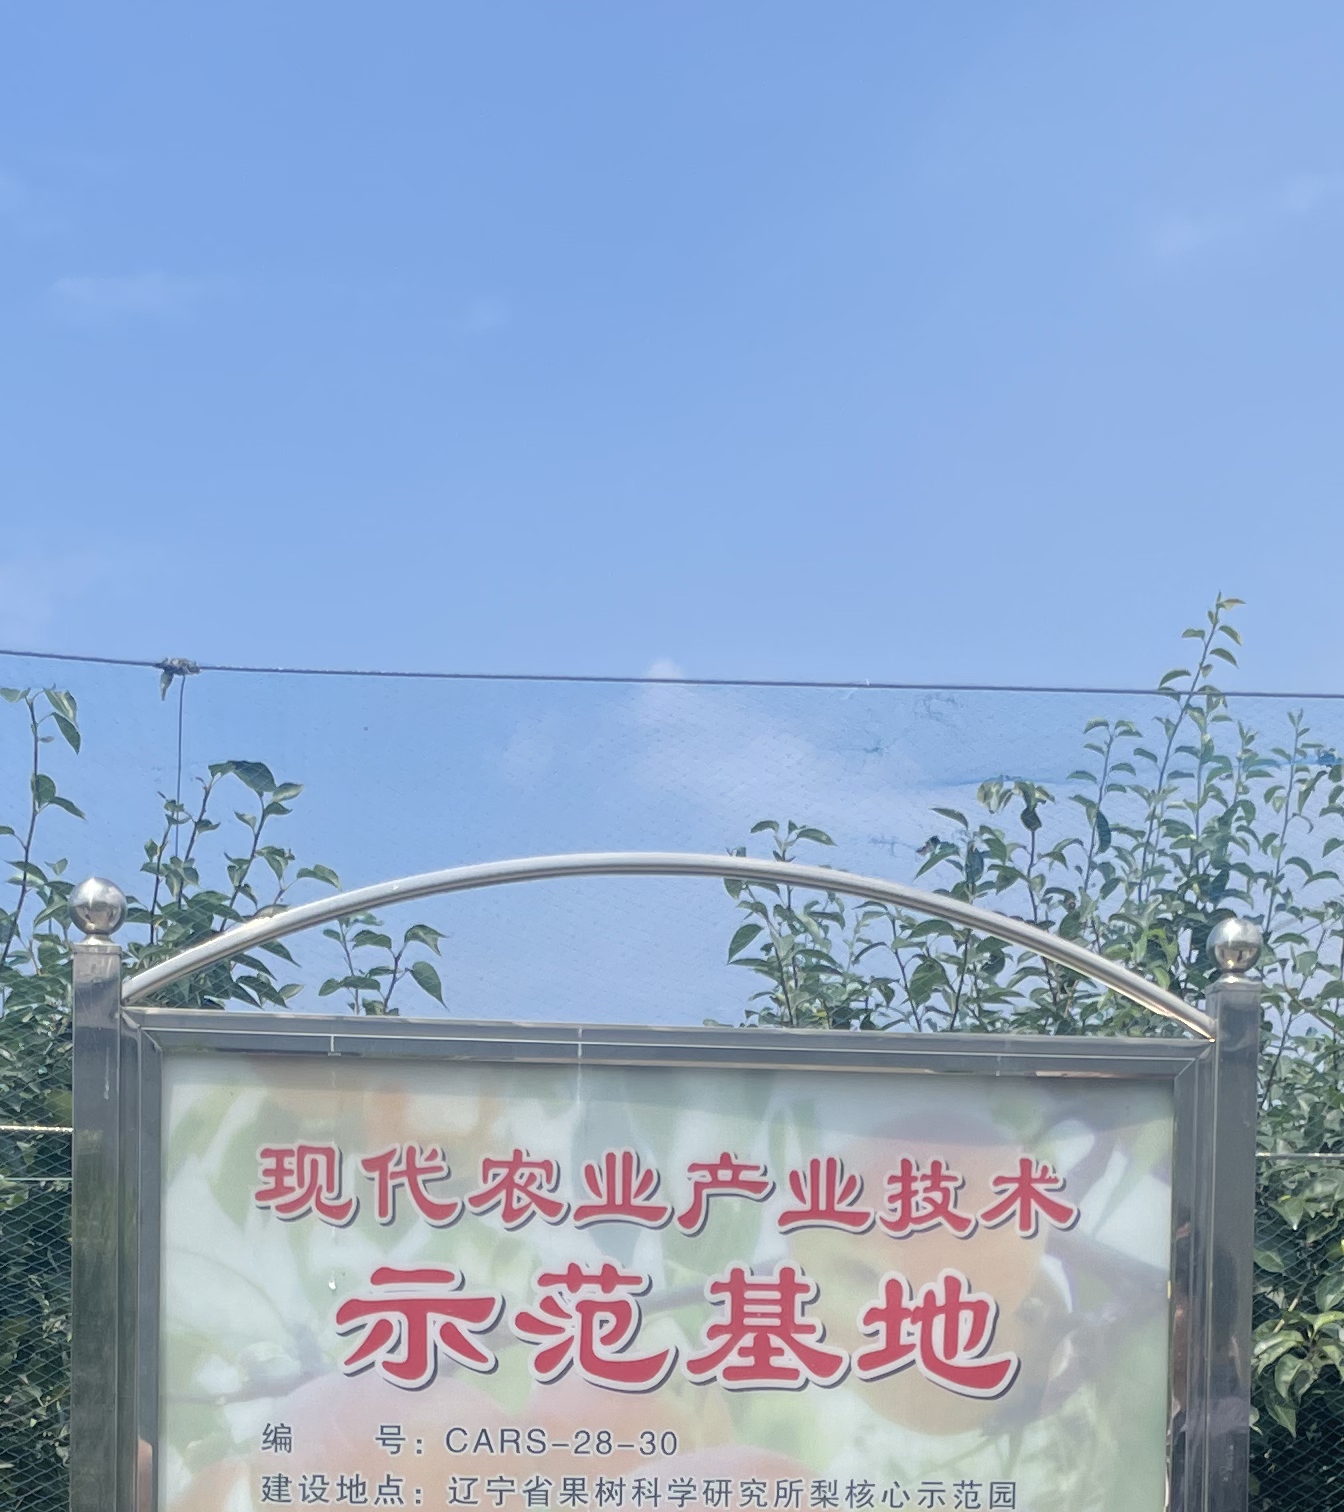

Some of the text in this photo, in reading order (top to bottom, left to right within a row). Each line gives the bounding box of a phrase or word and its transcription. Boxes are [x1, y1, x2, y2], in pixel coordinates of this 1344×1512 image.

[254, 1143, 1080, 1237] 现代农业产业技术
[334, 1261, 1021, 1399] 示范基地
